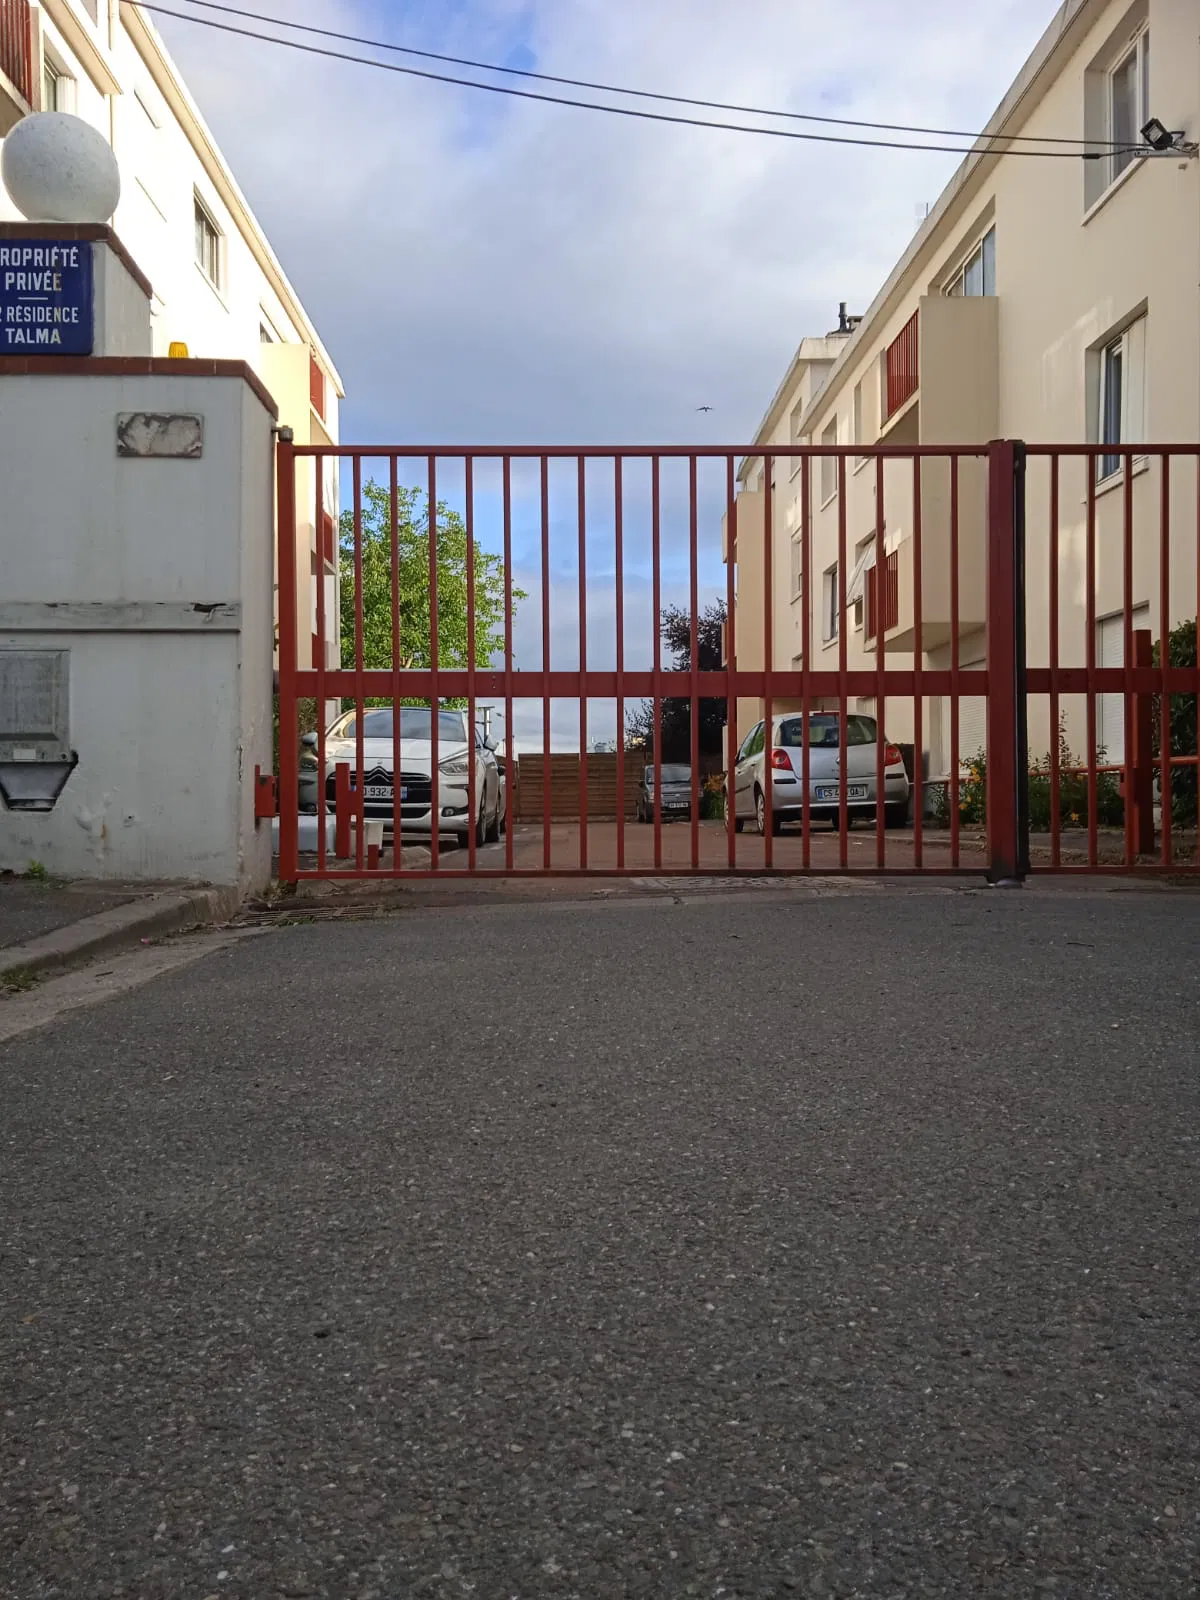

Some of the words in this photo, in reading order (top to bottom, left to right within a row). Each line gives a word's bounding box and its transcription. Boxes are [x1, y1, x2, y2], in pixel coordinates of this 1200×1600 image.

[0, 246, 79, 268] ROPRIÉTÉ
[5, 270, 62, 291] PRIVÉE
[6, 305, 79, 323] RÉSIDENCE
[5, 327, 62, 344] TALMA
